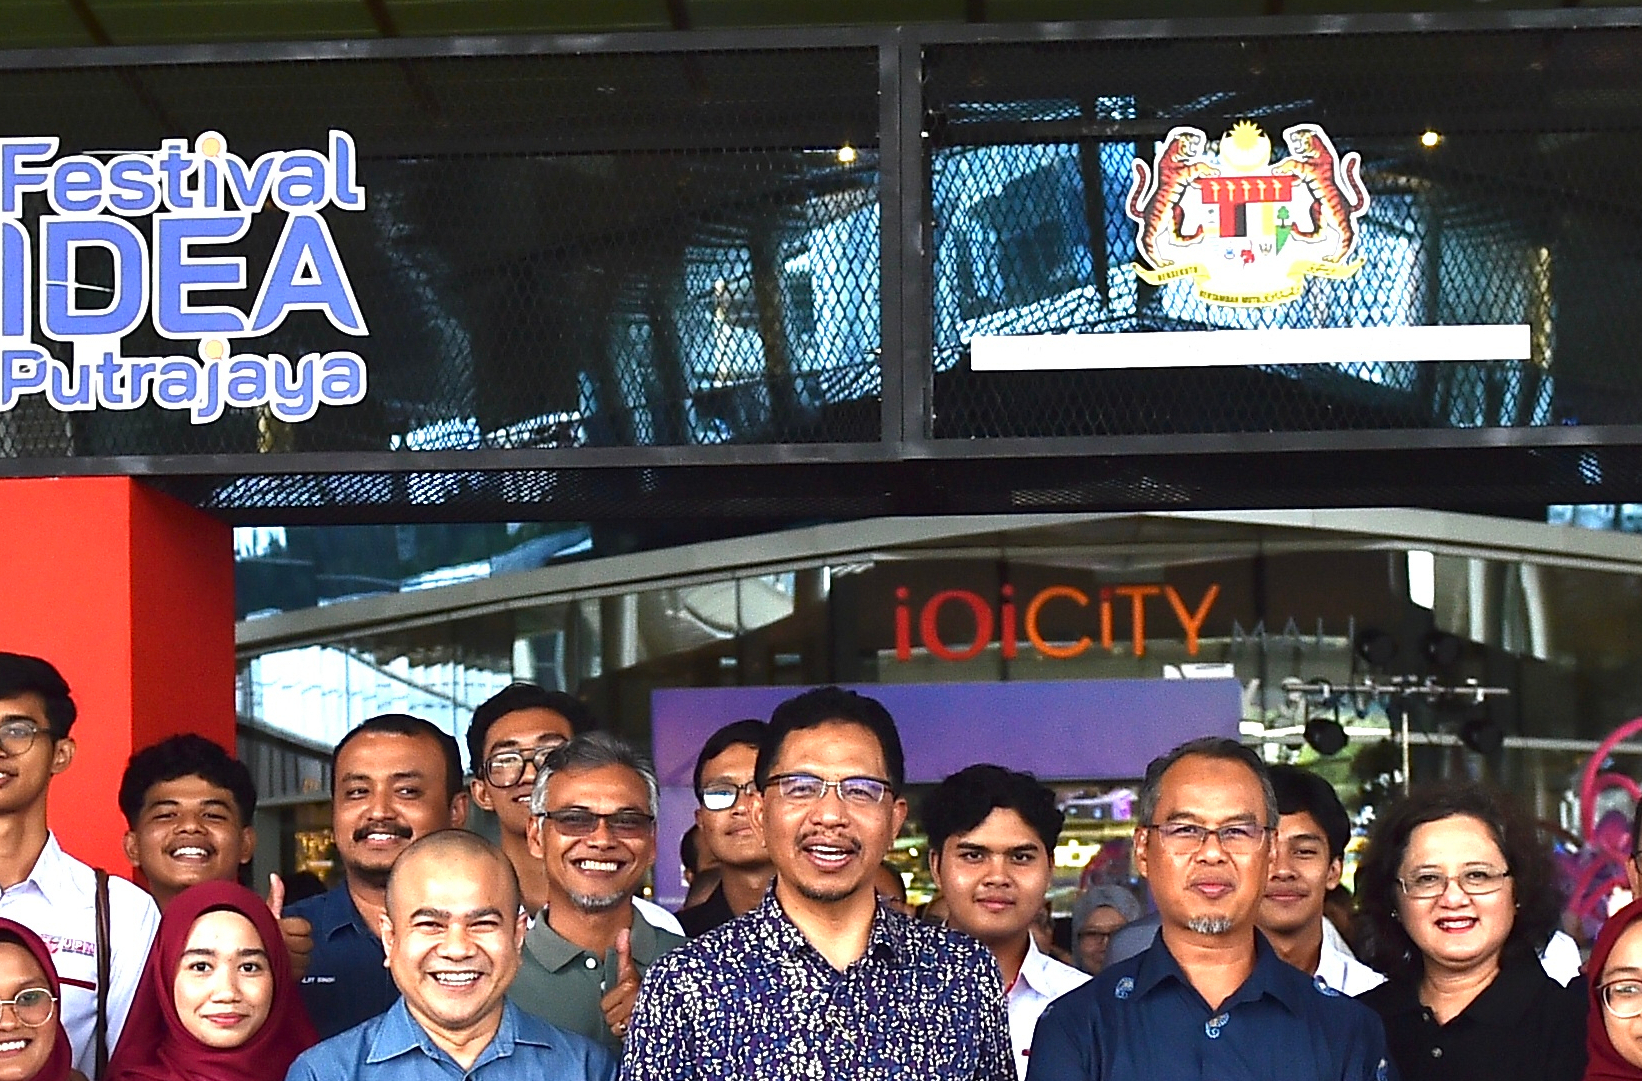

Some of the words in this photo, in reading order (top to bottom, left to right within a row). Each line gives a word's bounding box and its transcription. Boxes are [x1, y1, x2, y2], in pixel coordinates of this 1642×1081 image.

[0, 132, 361, 212] Festival
[1, 214, 365, 337] IDEA
[1, 339, 363, 420] Putrajaya
